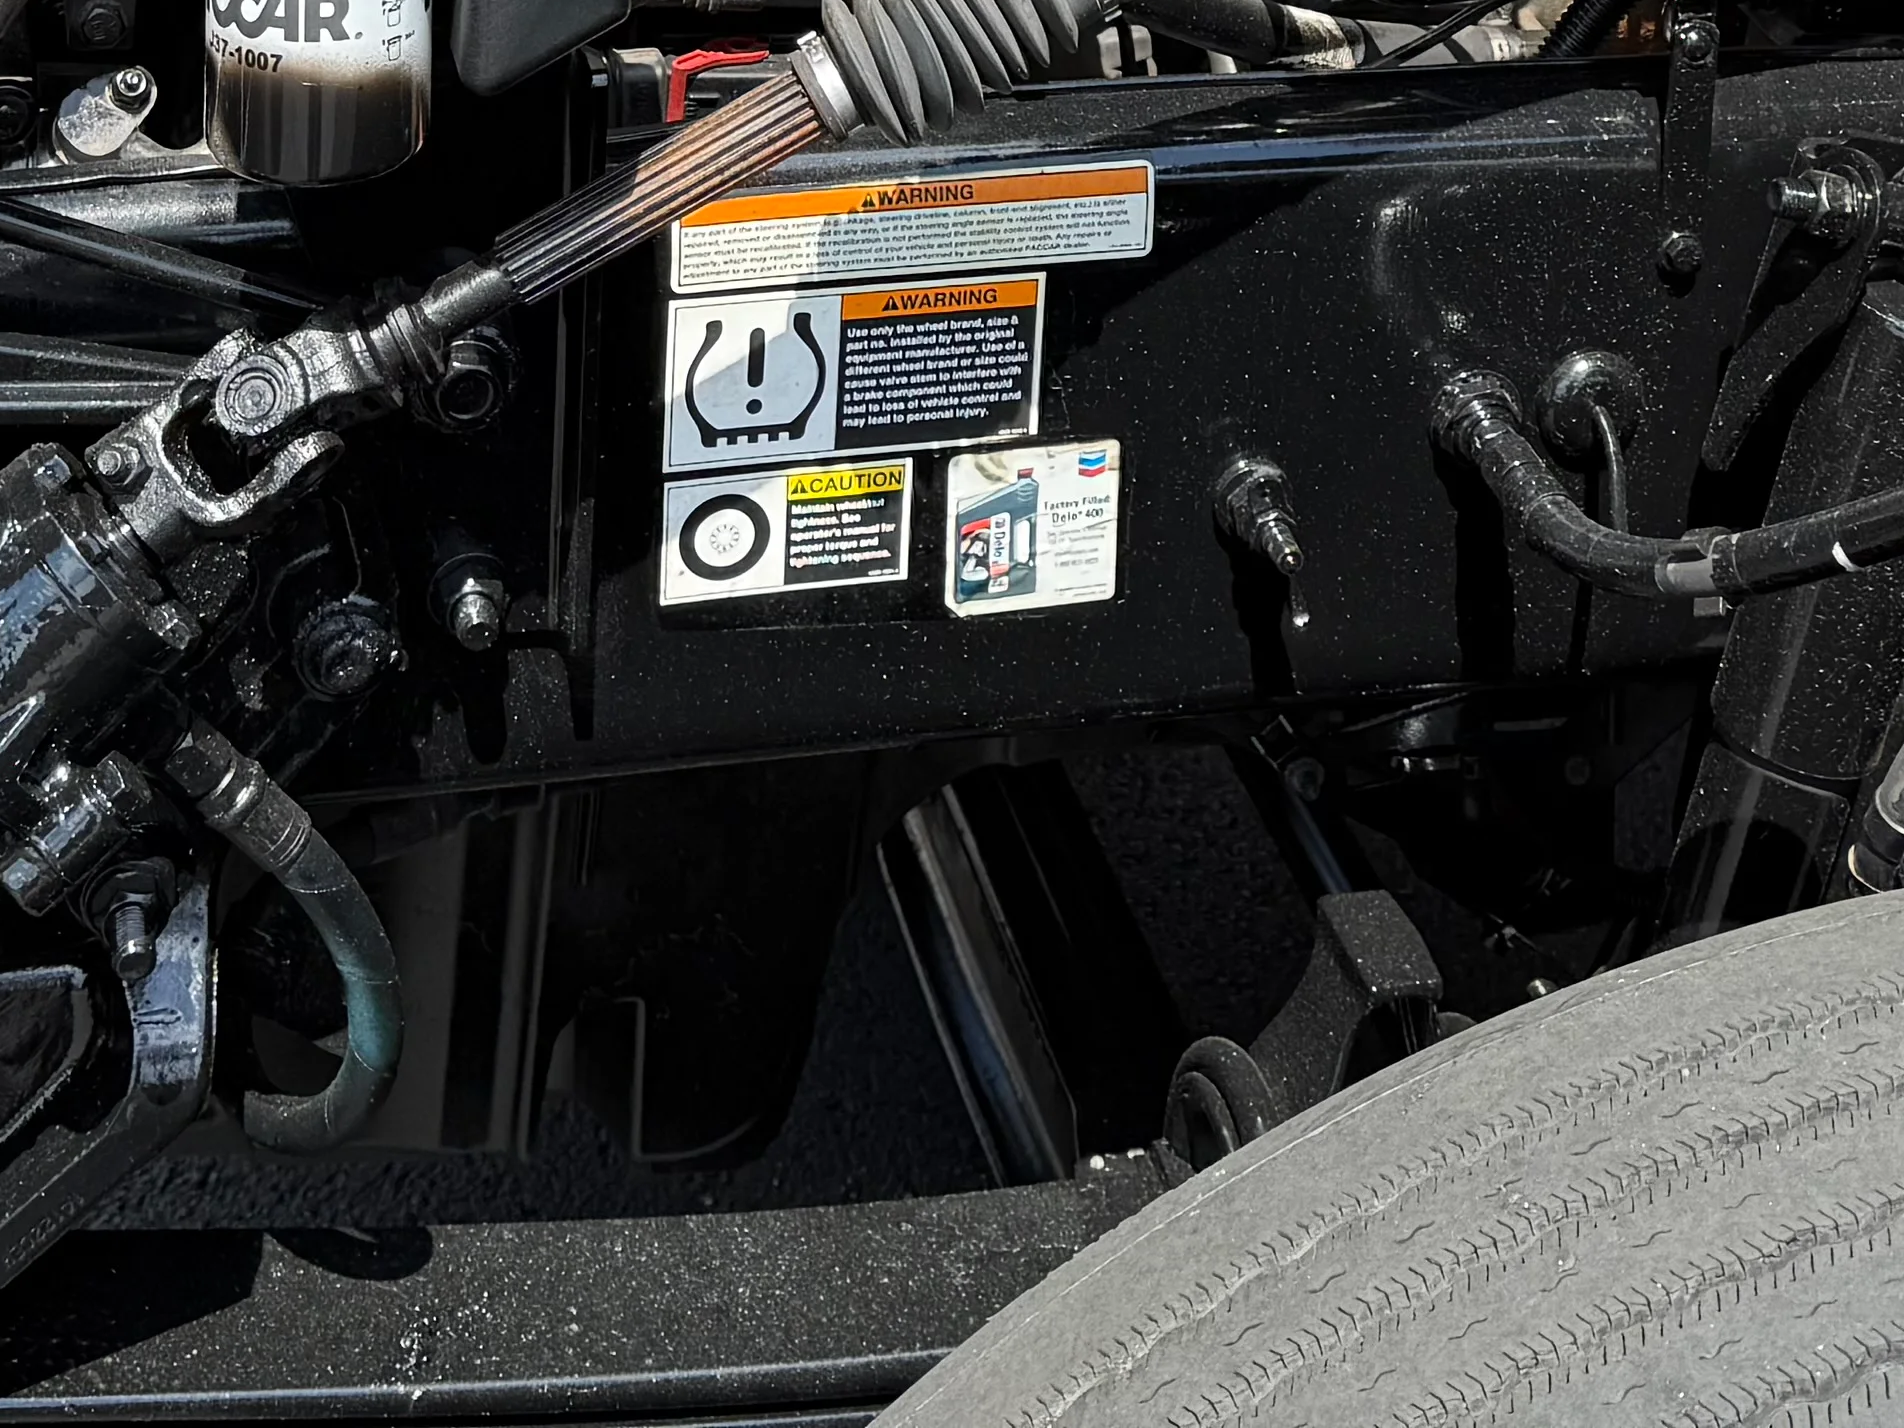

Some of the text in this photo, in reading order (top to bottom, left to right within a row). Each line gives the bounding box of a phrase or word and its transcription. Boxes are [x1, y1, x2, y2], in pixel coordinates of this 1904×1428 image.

[878, 185, 973, 205] WARNING
[900, 288, 998, 310] WARNING
[848, 328, 868, 338] Use
[871, 325, 894, 336] only
[896, 324, 914, 334] the
[916, 321, 948, 332] wheel
[950, 318, 984, 329] brand,
[986, 316, 1009, 327] size
[846, 328, 1014, 353] part no. installed by the original
[845, 341, 1024, 365] equipment manufacturer. Use of a
[845, 353, 1028, 376] different wheel brand or size could
[845, 366, 1021, 389] cause valve stem to interfere with
[844, 379, 1013, 401] a brake component which could
[844, 391, 1022, 414] lead to loss of vehicle control and
[843, 408, 989, 428] may lead to personal injury.
[810, 470, 902, 493] CAUTION
[1044, 500, 1079, 511] Factory
[1085, 509, 1104, 518] 400
[994, 531, 1005, 560] Delo
